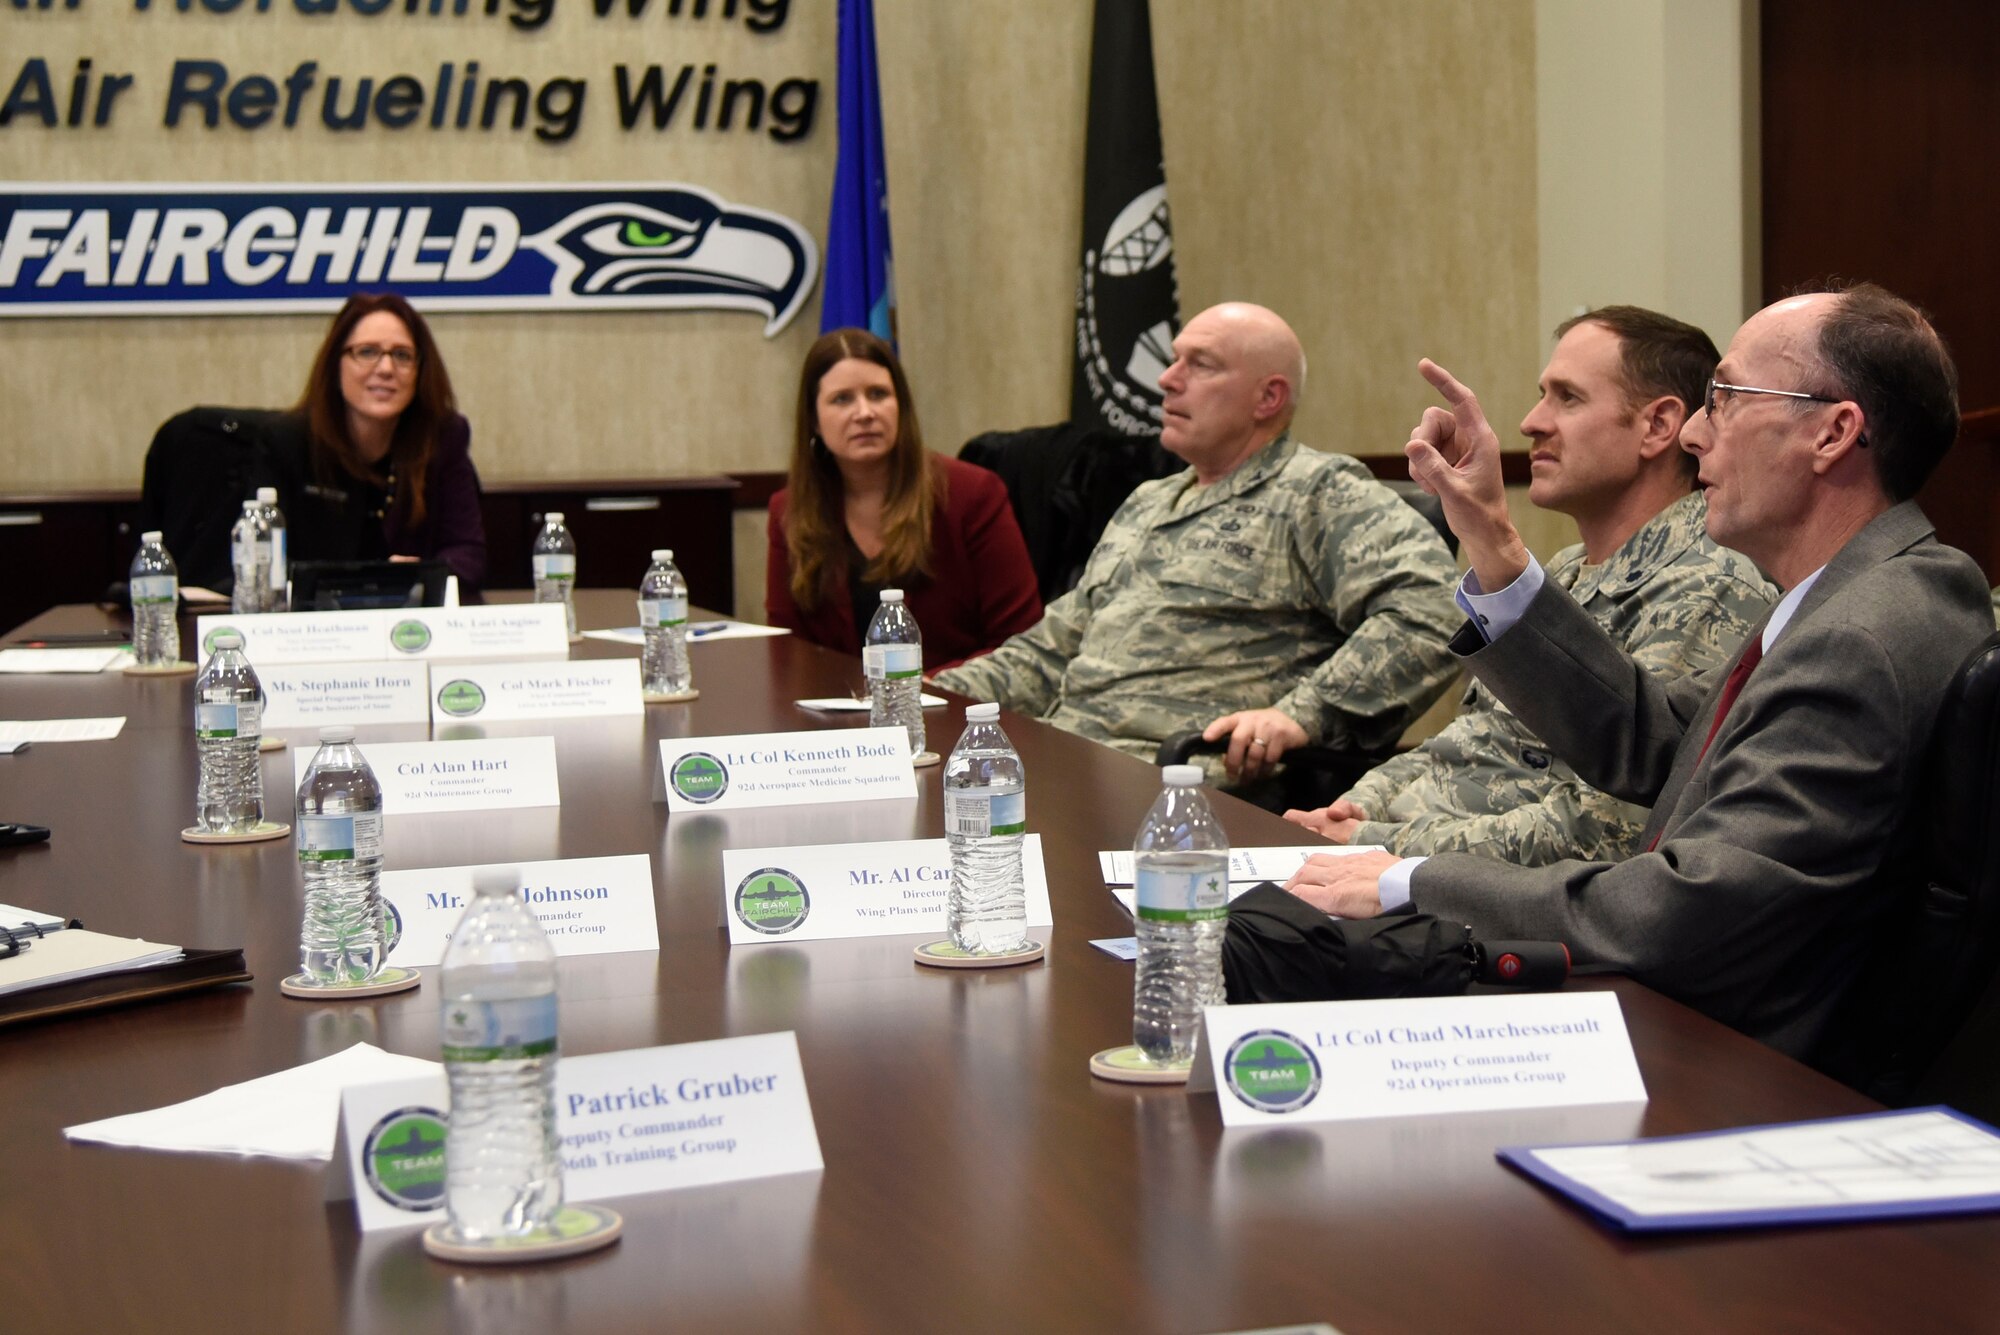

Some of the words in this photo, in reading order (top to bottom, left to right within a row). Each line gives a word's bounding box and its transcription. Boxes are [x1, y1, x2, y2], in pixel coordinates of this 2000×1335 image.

[0, 58, 132, 127] Air
[164, 59, 588, 143] Refueling
[613, 63, 820, 143] Wing
[0, 206, 521, 287] FAIRCHILD
[272, 680, 297, 692] Ms.
[302, 677, 369, 693] Stephanie
[376, 675, 411, 688] Horn
[501, 679, 523, 691] Col
[528, 678, 562, 690] Mark
[567, 676, 613, 688] Fischer
[727, 753, 745, 766] Lt
[750, 751, 778, 764] Col
[784, 747, 850, 762] Kenneth
[856, 744, 895, 757] Bode
[397, 763, 424, 775] Col
[429, 761, 466, 773] Alan
[472, 759, 508, 771] Hart
[788, 765, 847, 776] Commander
[430, 777, 485, 786] Commander
[685, 776, 713, 784] TEAM
[737, 782, 756, 791] 92d
[758, 779, 807, 792] Aerospace
[809, 777, 852, 788] Medicine
[854, 775, 900, 787] Squadron
[424, 789, 481, 798] Maintenance
[483, 787, 513, 796] Group
[849, 868, 883, 886] Mr.
[887, 866, 910, 884] Al
[916, 866, 951, 882] Car
[426, 891, 465, 911] Mr.
[523, 884, 609, 905] Johnson
[902, 888, 947, 900] Director
[743, 906, 803, 916] FAIRCHILD
[754, 900, 789, 909] TEAM
[856, 906, 886, 919] Wing
[889, 904, 918, 916] Plans
[921, 903, 942, 913] and
[569, 923, 606, 937] Group
[1315, 1031, 1339, 1048] Lt
[1346, 1028, 1382, 1046] Col
[1389, 1025, 1444, 1044] Chad
[1452, 1018, 1601, 1041] Marchesseault
[1391, 1056, 1448, 1072] Deputy
[1453, 1050, 1551, 1067] Commander
[1248, 1068, 1296, 1082] TEAM
[1386, 1075, 1417, 1091] 92d
[1420, 1072, 1510, 1091] Operations
[1514, 1068, 1567, 1085] Group
[567, 1082, 671, 1117] Patrick
[677, 1070, 778, 1104] Gruber
[619, 1112, 726, 1140] Commander
[605, 1143, 677, 1168] Training
[682, 1135, 737, 1158] Group
[391, 1154, 444, 1172] TEAM
